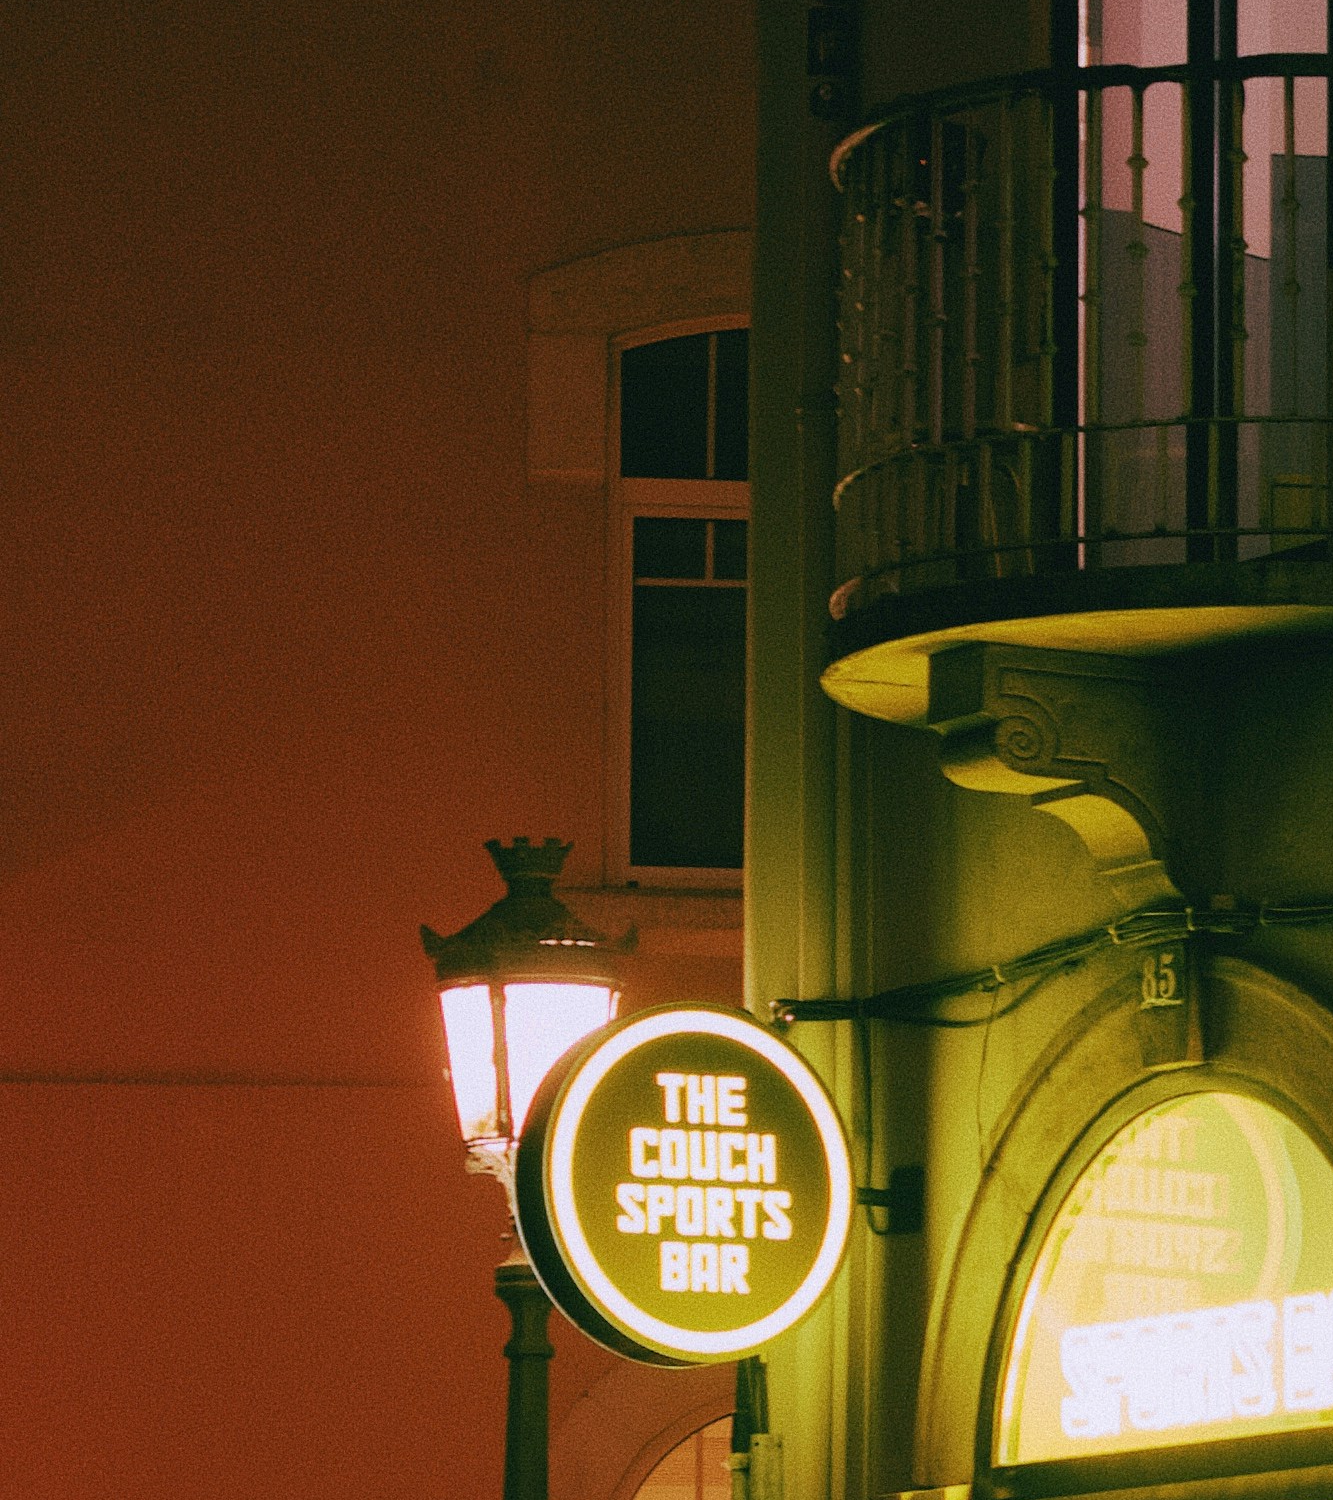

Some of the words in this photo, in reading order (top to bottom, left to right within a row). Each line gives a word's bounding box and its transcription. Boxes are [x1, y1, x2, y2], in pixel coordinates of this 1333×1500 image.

[655, 1071, 748, 1126] THE
[629, 1127, 777, 1184] COUCH
[615, 1182, 793, 1241] SPORTS
[659, 1241, 750, 1295] BAR
